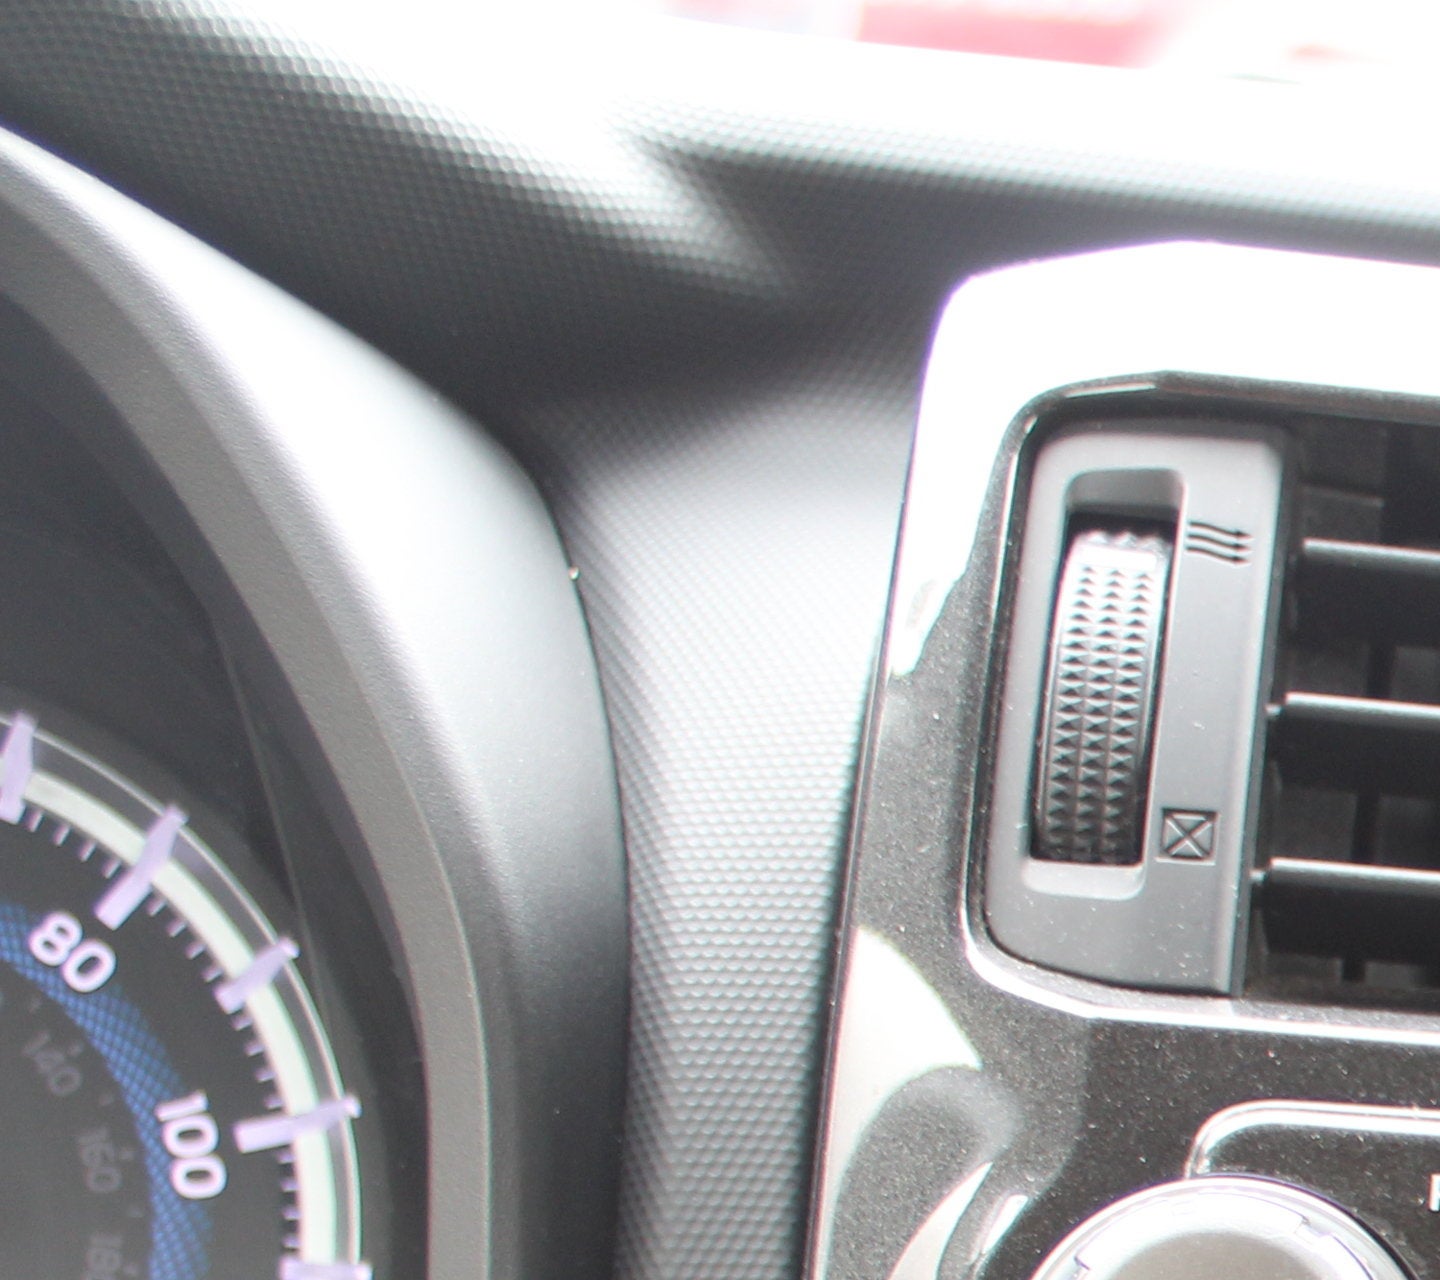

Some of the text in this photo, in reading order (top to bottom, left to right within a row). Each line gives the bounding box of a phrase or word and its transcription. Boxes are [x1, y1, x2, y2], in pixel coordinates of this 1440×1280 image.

[29, 910, 116, 993] 80
[19, 1028, 83, 1097] 140
[154, 1088, 228, 1200] 100
